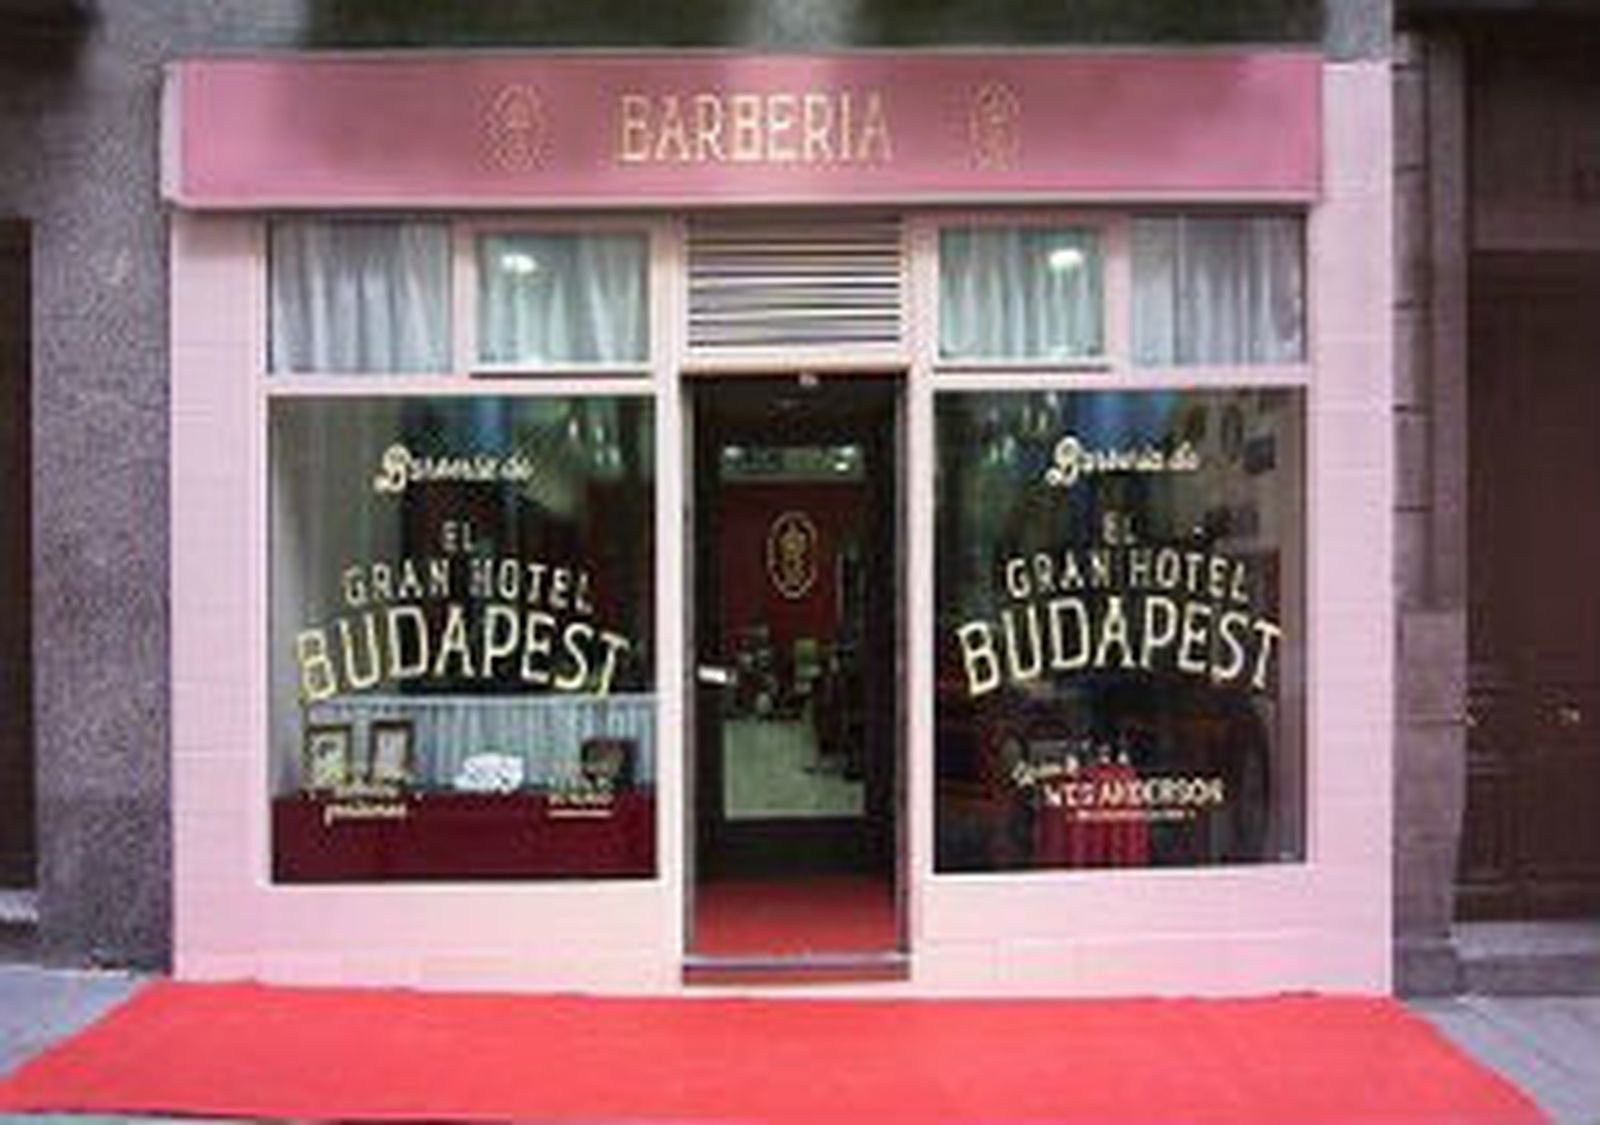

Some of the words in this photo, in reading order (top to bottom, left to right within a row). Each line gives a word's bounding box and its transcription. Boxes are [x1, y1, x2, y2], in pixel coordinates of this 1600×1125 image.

[619, 93, 893, 165] BARBERIA
[442, 521, 473, 551] EL
[1103, 512, 1139, 544] EL
[343, 559, 451, 606] GRAN
[470, 558, 594, 613] HOTEL
[1006, 549, 1110, 598] GRAN
[1129, 549, 1249, 602] HOTEL
[297, 606, 630, 702] BUDAPEST
[957, 596, 1281, 697] BUDAPEST
